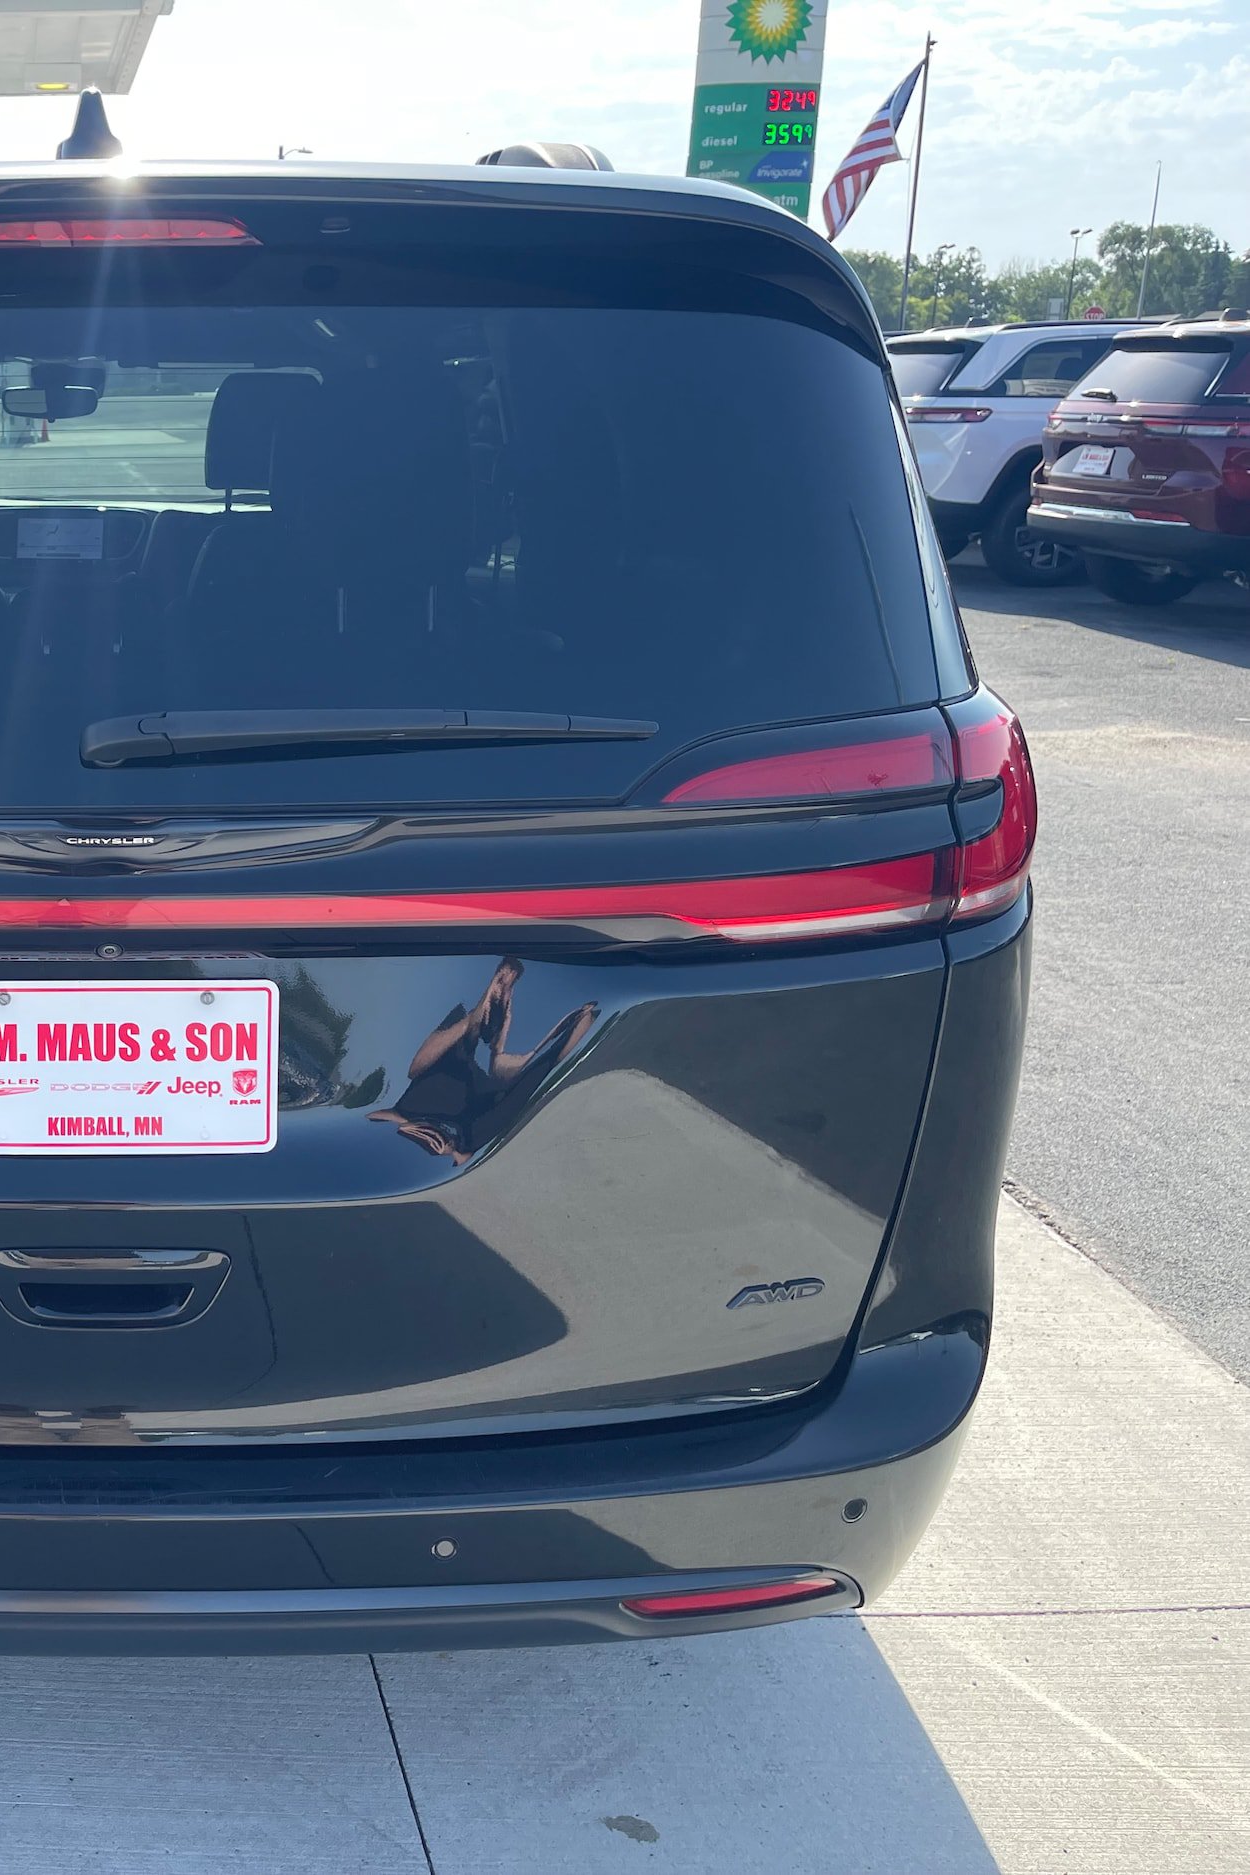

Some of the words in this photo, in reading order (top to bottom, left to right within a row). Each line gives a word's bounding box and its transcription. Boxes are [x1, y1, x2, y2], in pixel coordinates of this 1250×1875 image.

[704, 102, 748, 115] regular
[701, 135, 738, 147] diesel
[764, 123, 813, 145] 3599
[699, 160, 714, 170] BP
[66, 837, 155, 845] CHRYSLER
[37, 1022, 140, 1062] MAUS
[150, 1028, 177, 1062] &
[185, 1022, 258, 1061] SON
[167, 1076, 222, 1097] Jeep
[47, 1116, 130, 1138] KIMBALL,
[134, 1116, 163, 1136] MN
[726, 1277, 825, 1309] AWD
